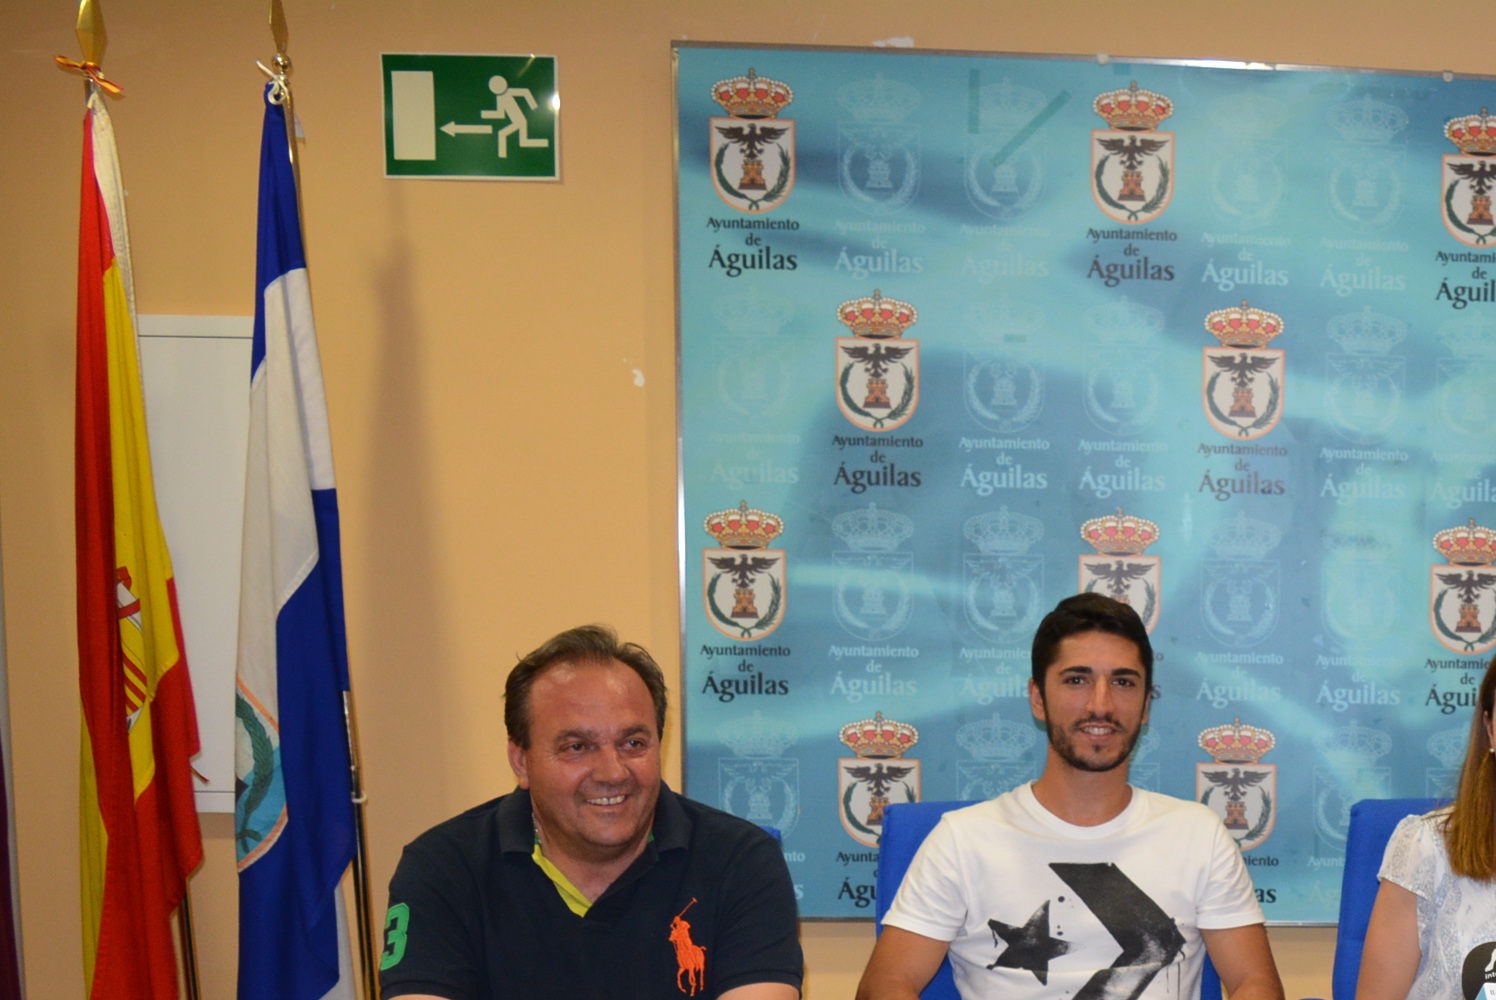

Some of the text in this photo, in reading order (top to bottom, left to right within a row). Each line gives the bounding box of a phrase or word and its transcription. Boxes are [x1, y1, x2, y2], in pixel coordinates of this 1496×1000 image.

[705, 217, 800, 233] Ayuntamiento
[745, 232, 762, 246] de
[1086, 227, 1177, 243] Ayuntamiento
[1201, 232, 1291, 248] Ayuntamiento
[1123, 243, 1140, 257] de
[1319, 237, 1408, 253] Ayuntamiento
[707, 244, 798, 278] Águilas
[1238, 248, 1254, 261] de
[1356, 253, 1371, 266] de
[834, 247, 924, 280] Águilas
[1087, 255, 1175, 288] Águilas
[1202, 259, 1289, 292] Águilas
[1320, 264, 1405, 297] Águilas
[1472, 266, 1487, 280] de
[832, 434, 924, 450] Ayuntamiento
[959, 436, 1050, 452] Ayuntamiento
[1078, 439, 1168, 455] Ayuntamiento
[870, 450, 886, 463] de
[996, 452, 1013, 465] de
[1198, 443, 1287, 458] Ayuntamiento
[1115, 454, 1131, 467] de
[1234, 458, 1250, 471] de
[833, 462, 922, 494] Águilas
[960, 463, 1048, 496] Águilas
[1080, 466, 1166, 498] Águilas
[1199, 469, 1284, 502] Águilas
[1321, 473, 1405, 506] Águilas
[699, 644, 792, 660] Ayuntamiento
[959, 647, 1032, 663] Ayuntamie
[738, 659, 754, 672] de
[996, 661, 1012, 675] de
[1316, 655, 1403, 670] Ayuntamiento
[1424, 658, 1491, 673] Ayuntamie
[1351, 669, 1367, 682] de
[1460, 672, 1475, 685] de
[701, 671, 790, 703] Águilas
[830, 671, 918, 703] Águilas
[960, 672, 1029, 705] Águila
[1196, 677, 1280, 709] Águilas
[1317, 681, 1400, 712] Águilas
[1425, 683, 1477, 715] Águi
[836, 851, 880, 866] Ayunta
[379, 902, 410, 971] 3
